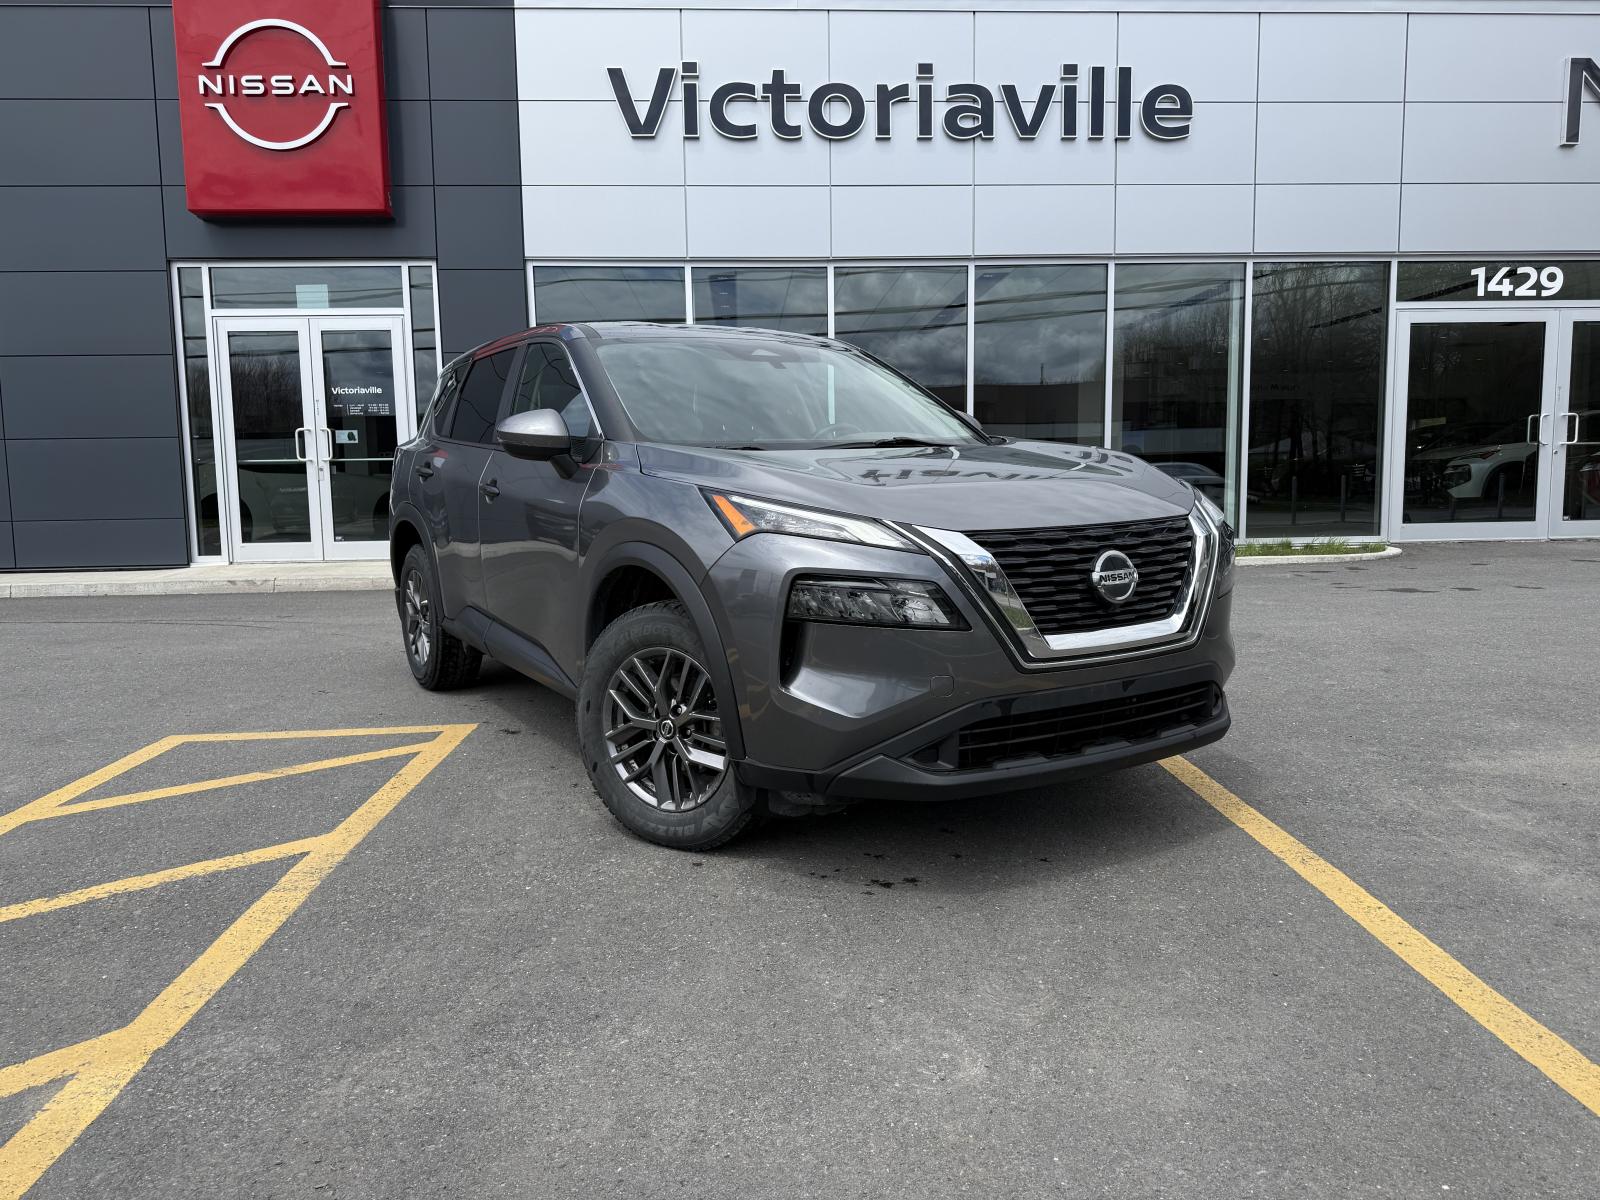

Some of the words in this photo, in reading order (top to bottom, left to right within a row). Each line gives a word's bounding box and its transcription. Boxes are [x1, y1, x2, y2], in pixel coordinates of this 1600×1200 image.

[198, 74, 354, 95] NISSAN
[605, 60, 1194, 141] Victoriaville
[1470, 266, 1564, 297] 1429
[331, 386, 383, 394] Victoriaville
[1099, 571, 1135, 583] NISSAN
